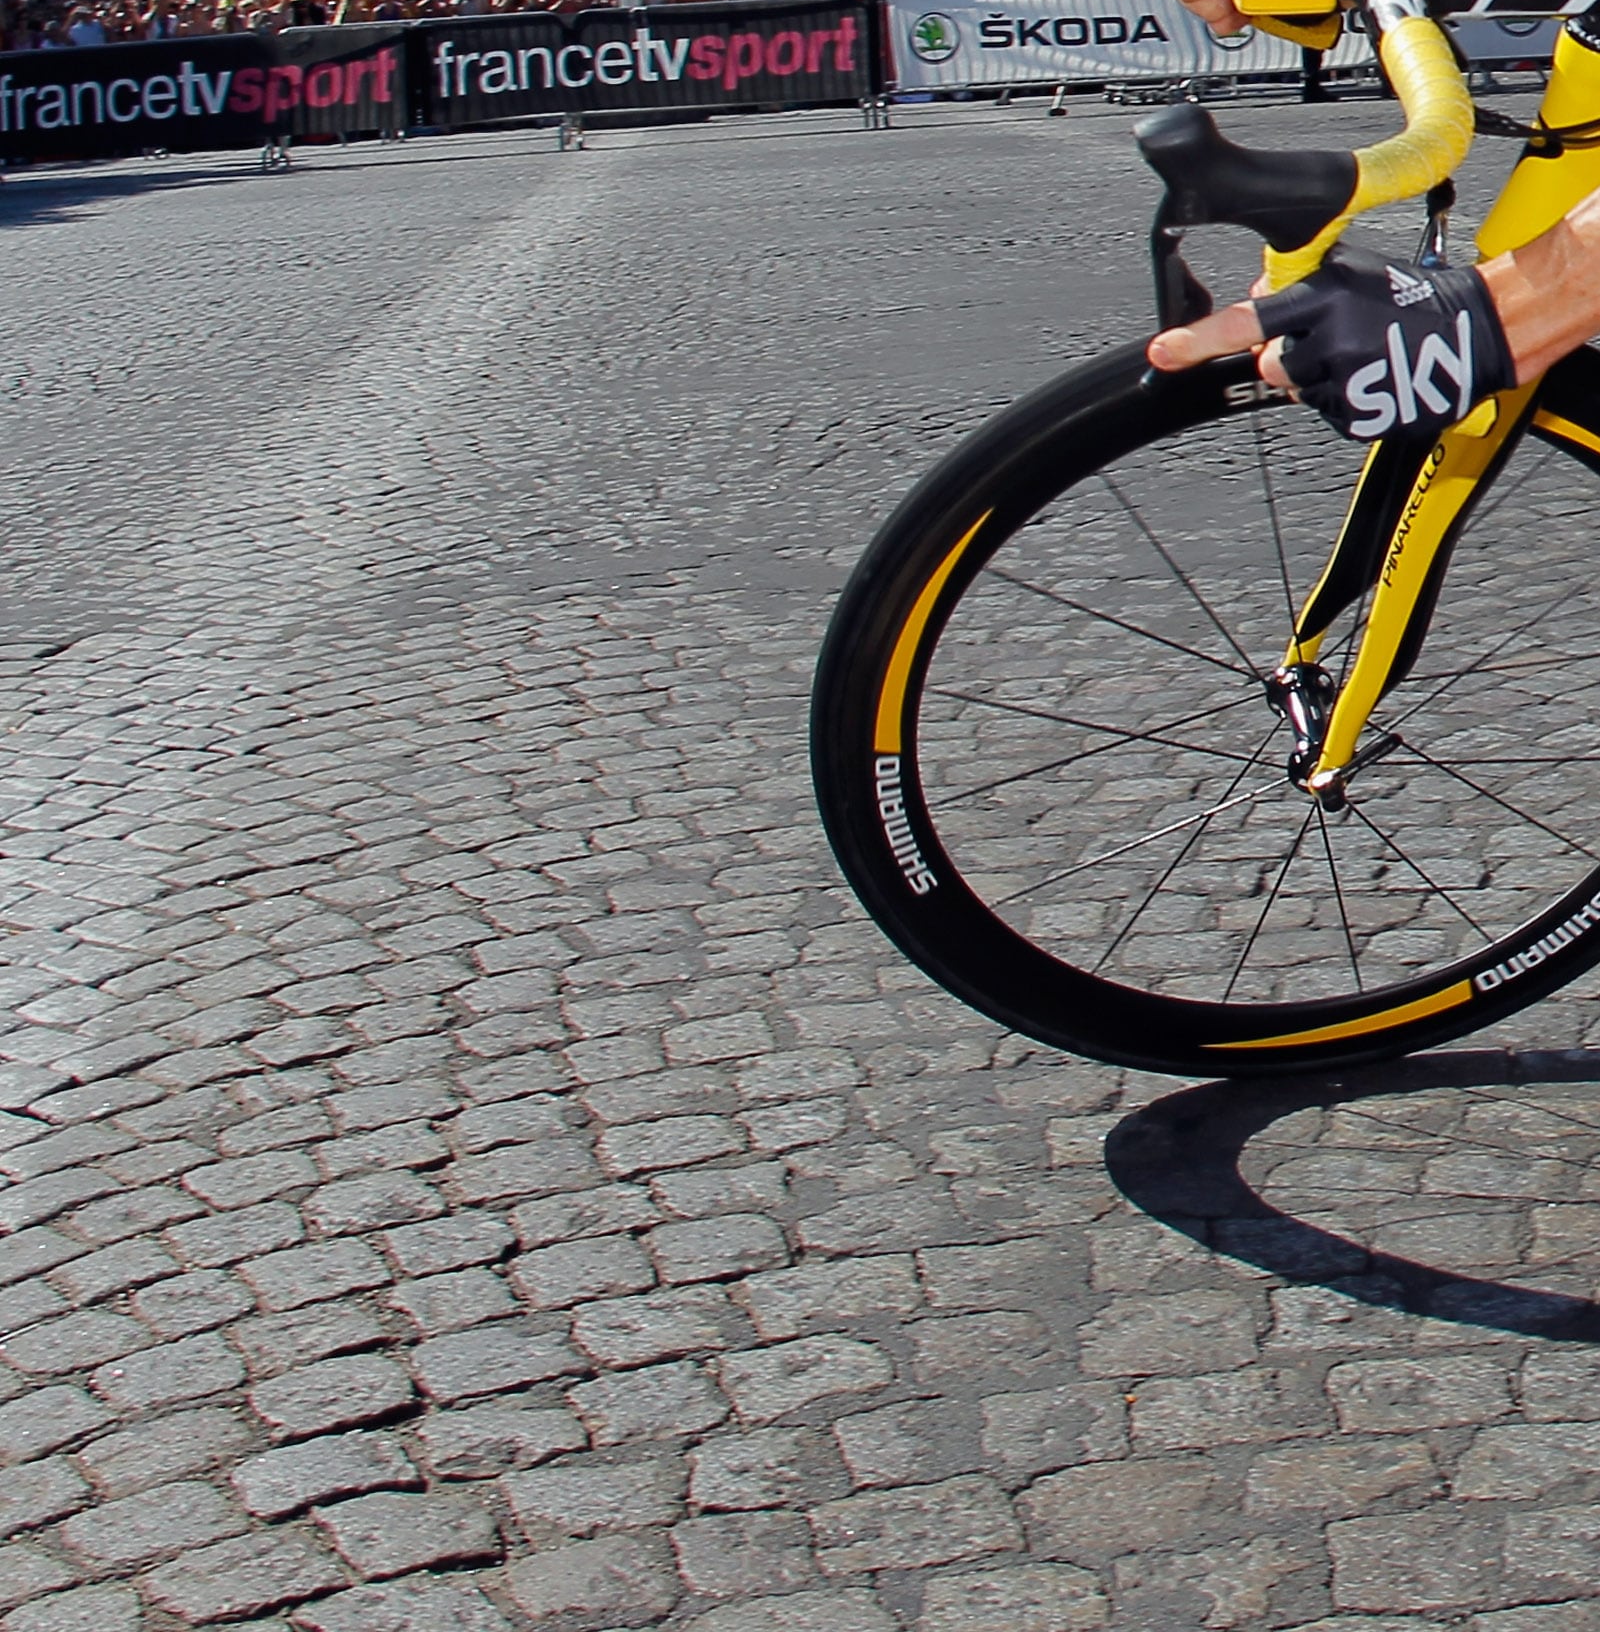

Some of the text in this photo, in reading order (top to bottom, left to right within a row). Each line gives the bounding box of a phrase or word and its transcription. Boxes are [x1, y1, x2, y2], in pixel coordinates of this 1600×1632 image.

[432, 14, 858, 98] francetvsport
[978, 13, 1169, 50] ŠKODA
[1345, 309, 1472, 438] sky
[1382, 441, 1445, 587] PINARELLO
[874, 755, 938, 896] SHIMANO
